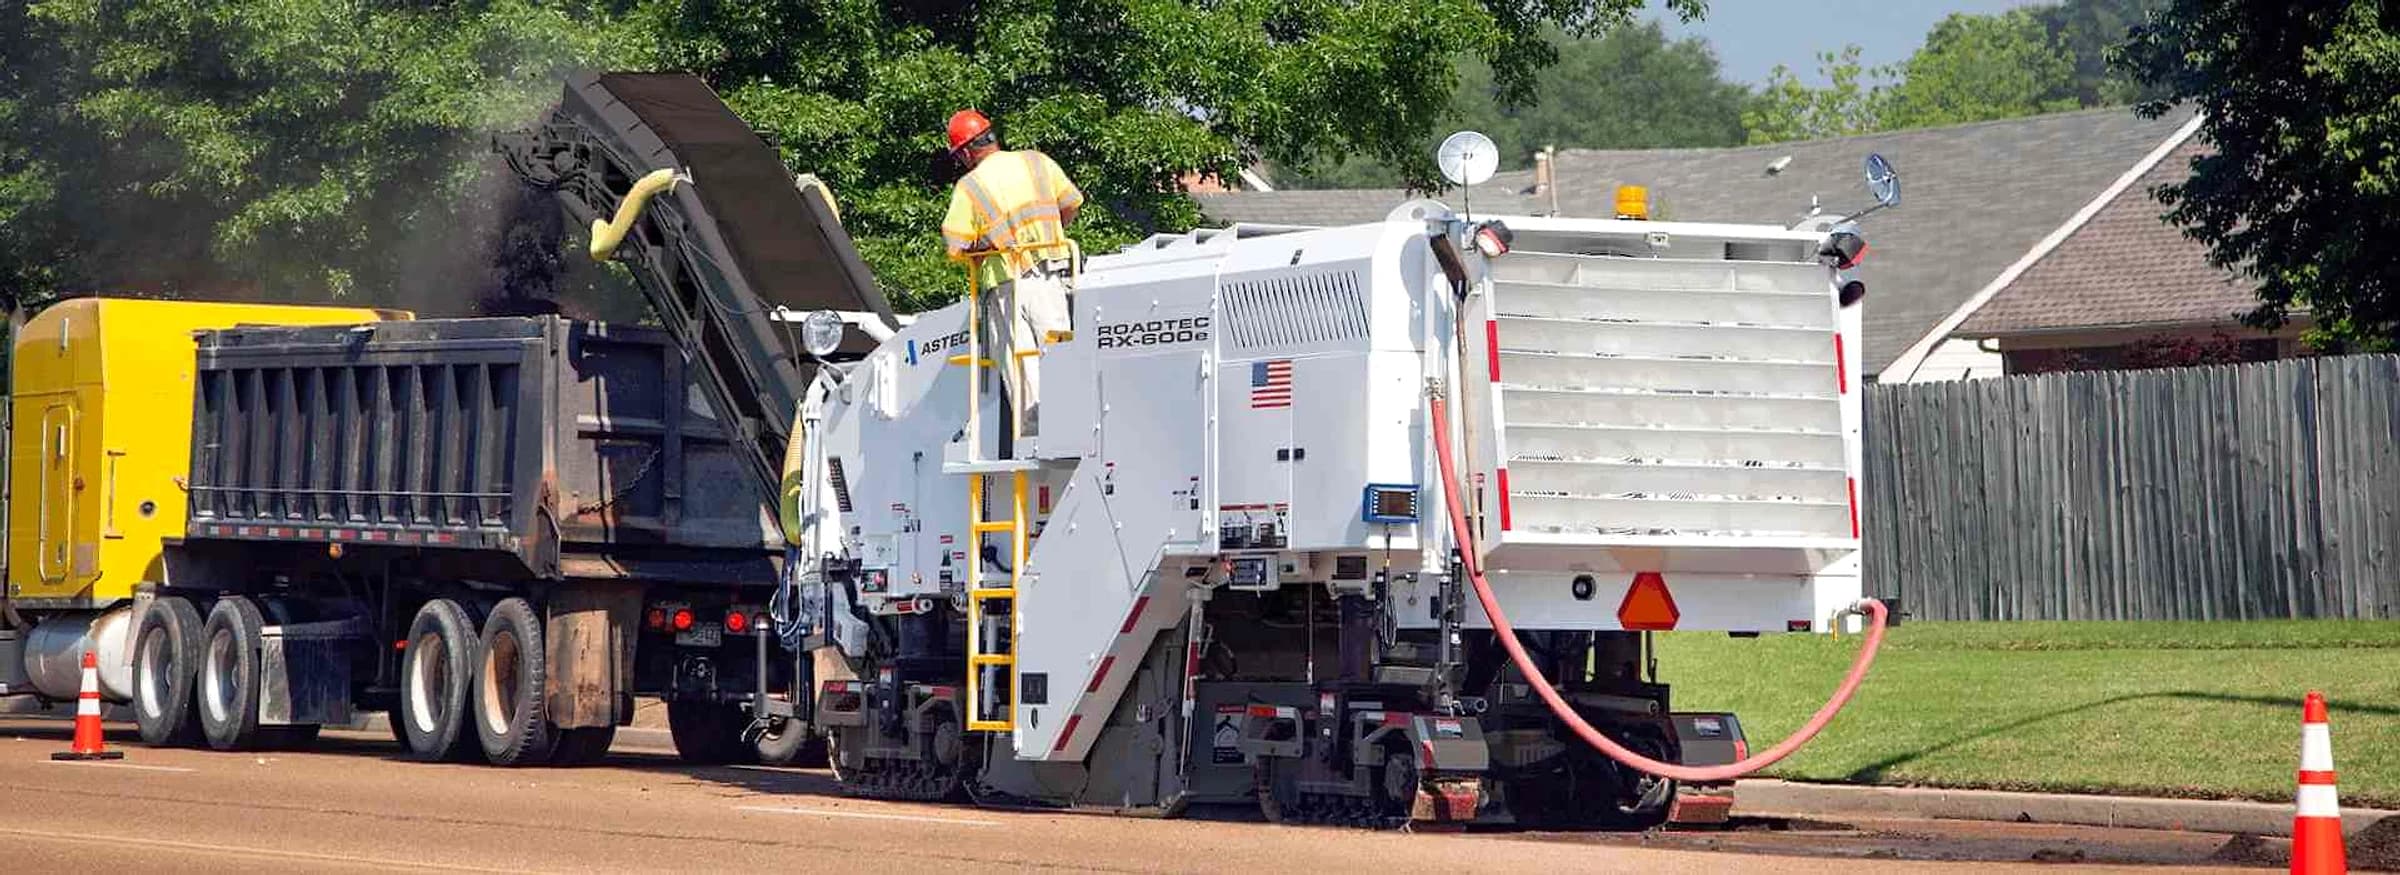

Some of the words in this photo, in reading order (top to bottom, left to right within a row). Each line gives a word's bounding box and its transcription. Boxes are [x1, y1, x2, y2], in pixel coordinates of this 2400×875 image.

[1098, 317, 1209, 336] ROADTEC
[921, 330, 970, 355] ASTEC
[1098, 330, 1208, 349] RX-600e
